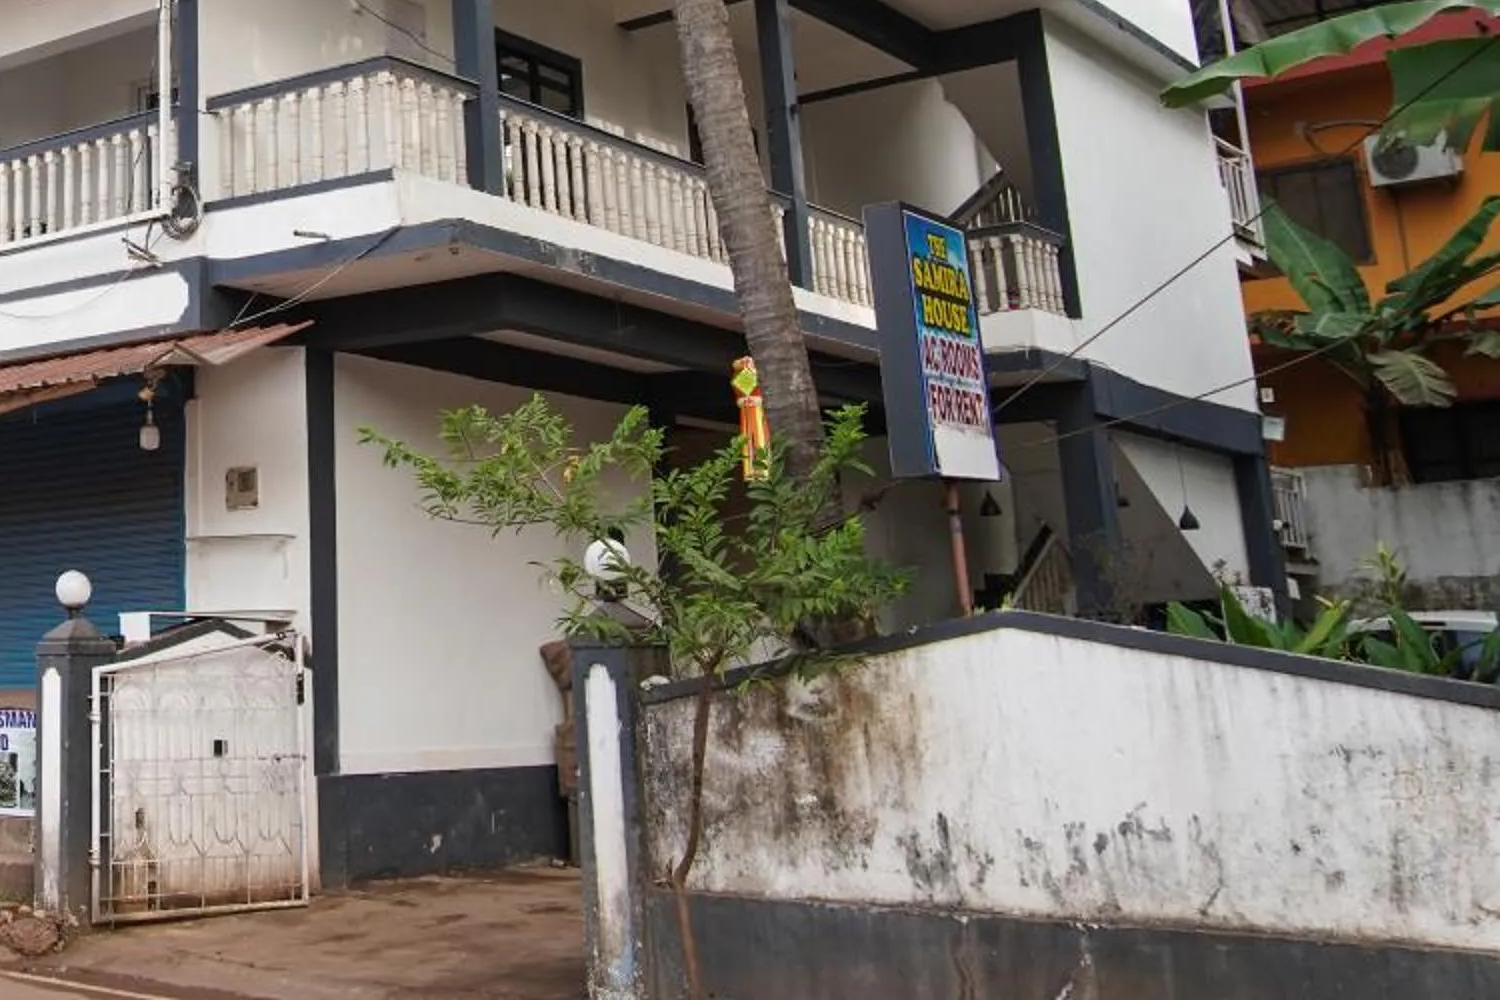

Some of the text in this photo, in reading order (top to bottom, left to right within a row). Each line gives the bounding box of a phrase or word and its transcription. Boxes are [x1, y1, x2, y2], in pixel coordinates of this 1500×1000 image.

[923, 294, 970, 334] HOUSE
[930, 383, 984, 426] FOR RENT
